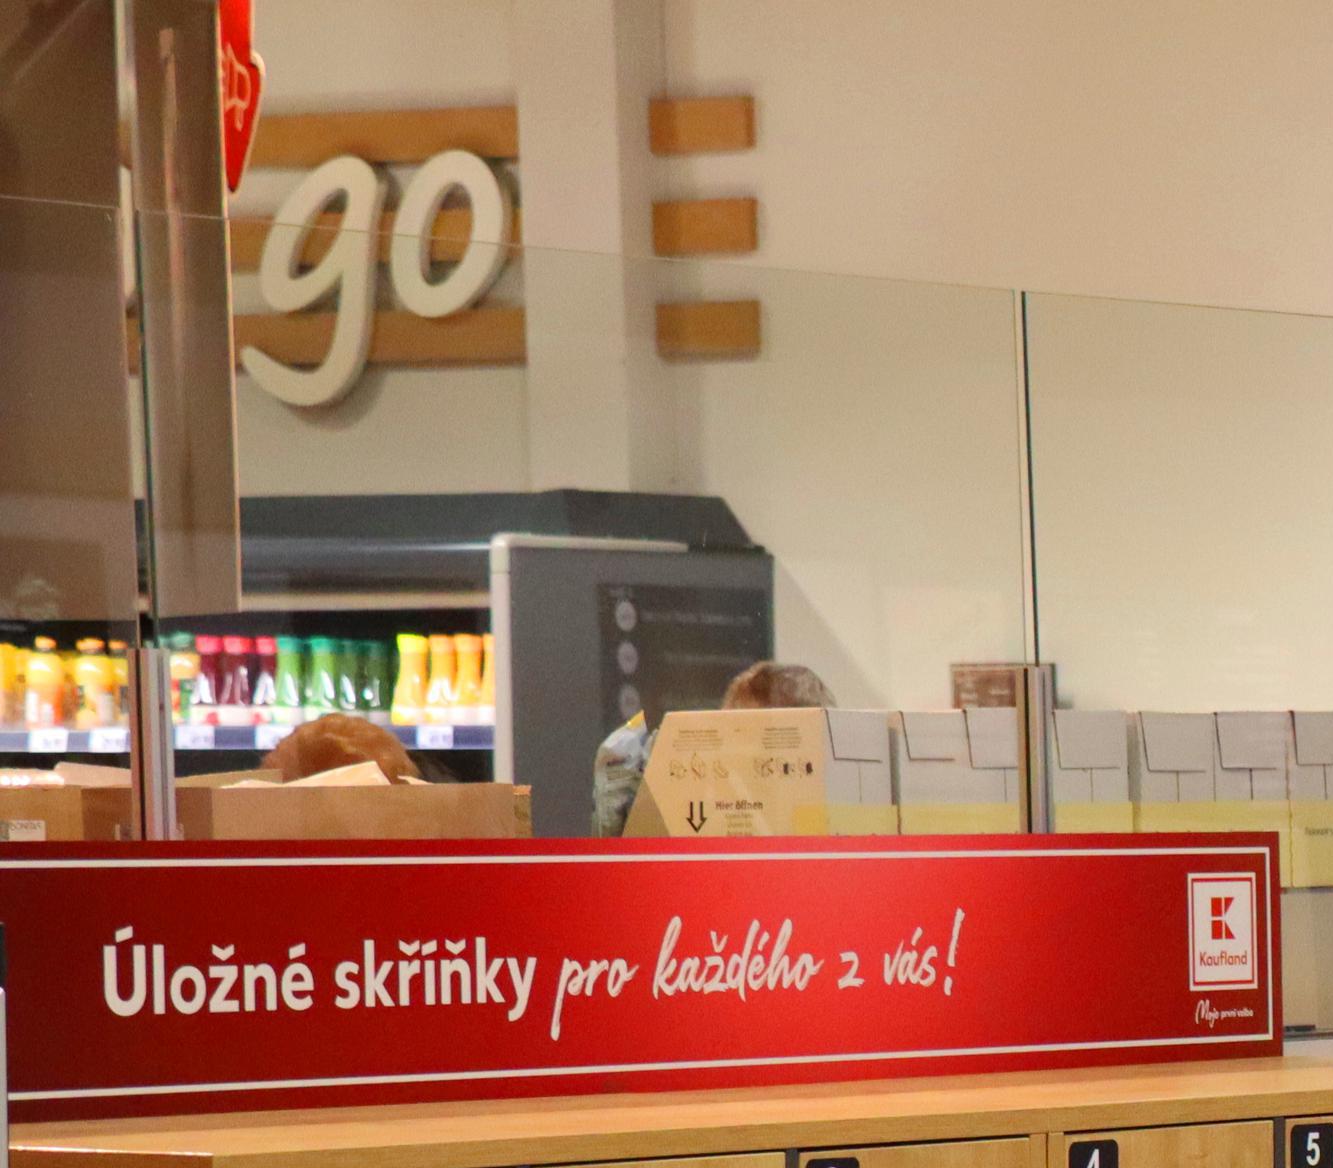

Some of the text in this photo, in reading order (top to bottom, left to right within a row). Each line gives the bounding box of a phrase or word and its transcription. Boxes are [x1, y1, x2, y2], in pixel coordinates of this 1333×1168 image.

[240, 149, 504, 406] go
[103, 908, 965, 1041] Úložné skříňky pro každého z vás!
[1200, 951, 1248, 967] Kaufland
[1306, 1131, 1320, 1166] 5
